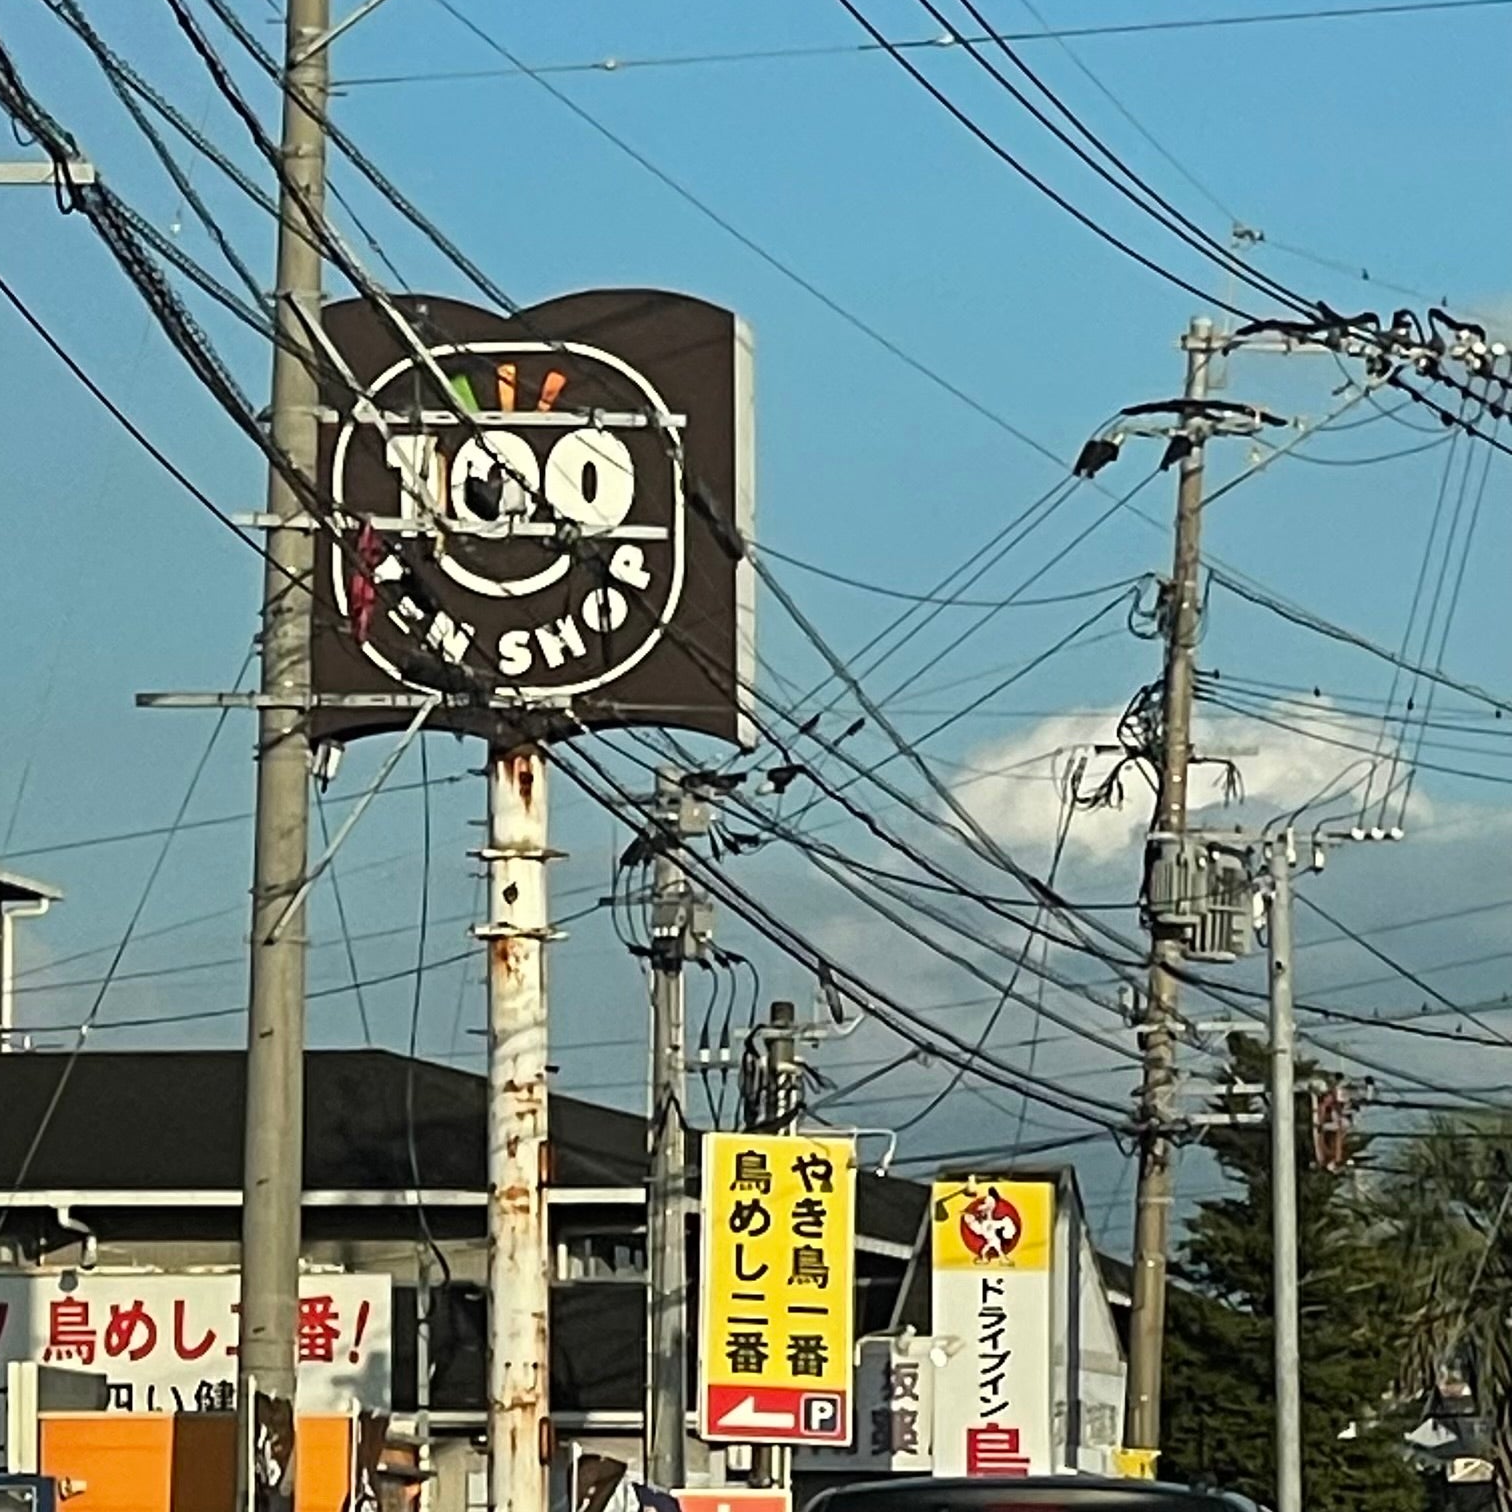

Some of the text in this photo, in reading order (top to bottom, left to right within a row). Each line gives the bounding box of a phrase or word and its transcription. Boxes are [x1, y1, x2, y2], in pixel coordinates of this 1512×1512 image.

[385, 428, 635, 537] 100
[498, 544, 651, 676] SHOP
[726, 1149, 772, 1375] 鳥めし二番
[788, 1153, 833, 1377] やき鳥一番
[811, 1400, 834, 1430] P
